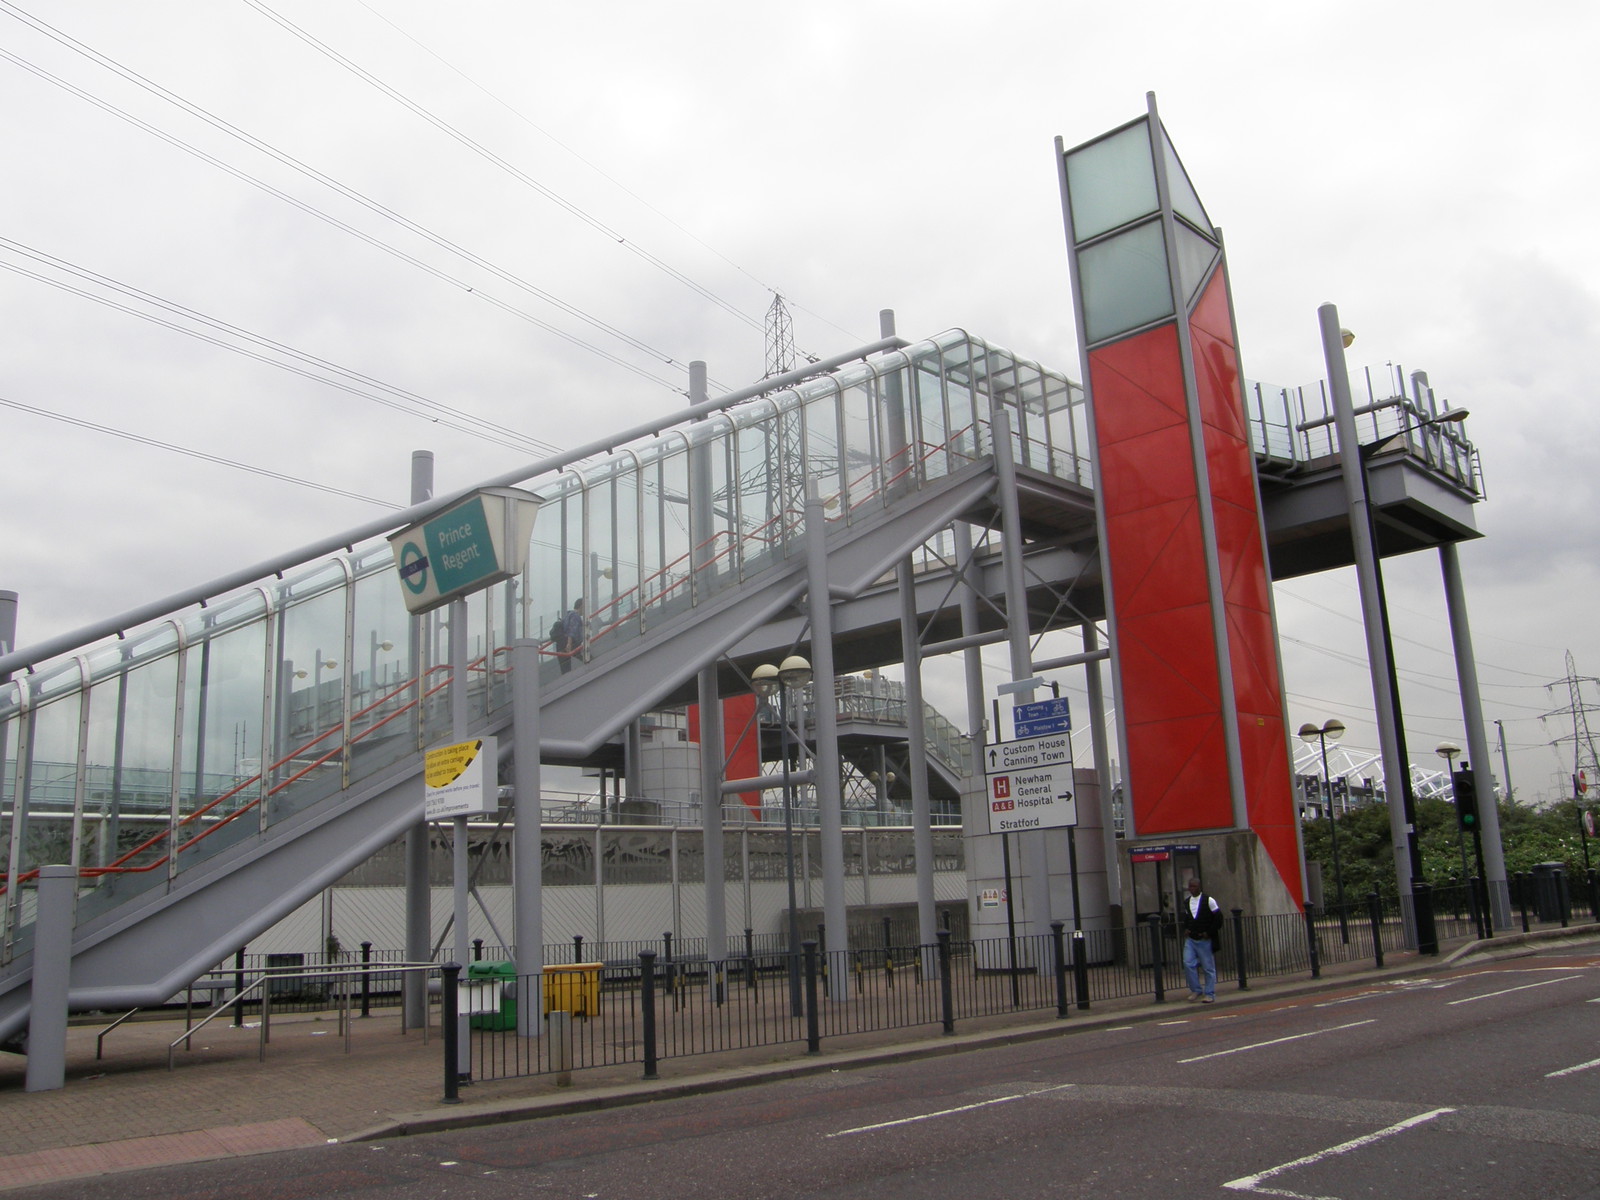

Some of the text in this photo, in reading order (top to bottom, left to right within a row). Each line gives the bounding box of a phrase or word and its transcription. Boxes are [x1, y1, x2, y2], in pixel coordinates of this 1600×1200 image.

[438, 523, 472, 548] Prince
[442, 543, 480, 570] Regent
[1027, 704, 1044, 712] Canning
[1003, 739, 1066, 756] Custom House
[1004, 752, 1064, 767] Canning Town
[1015, 774, 1052, 785] Newham
[996, 780, 1007, 794] H
[1018, 784, 1052, 796] General
[1018, 796, 1053, 808] Hospital
[1000, 818, 1040, 830] Stratford
